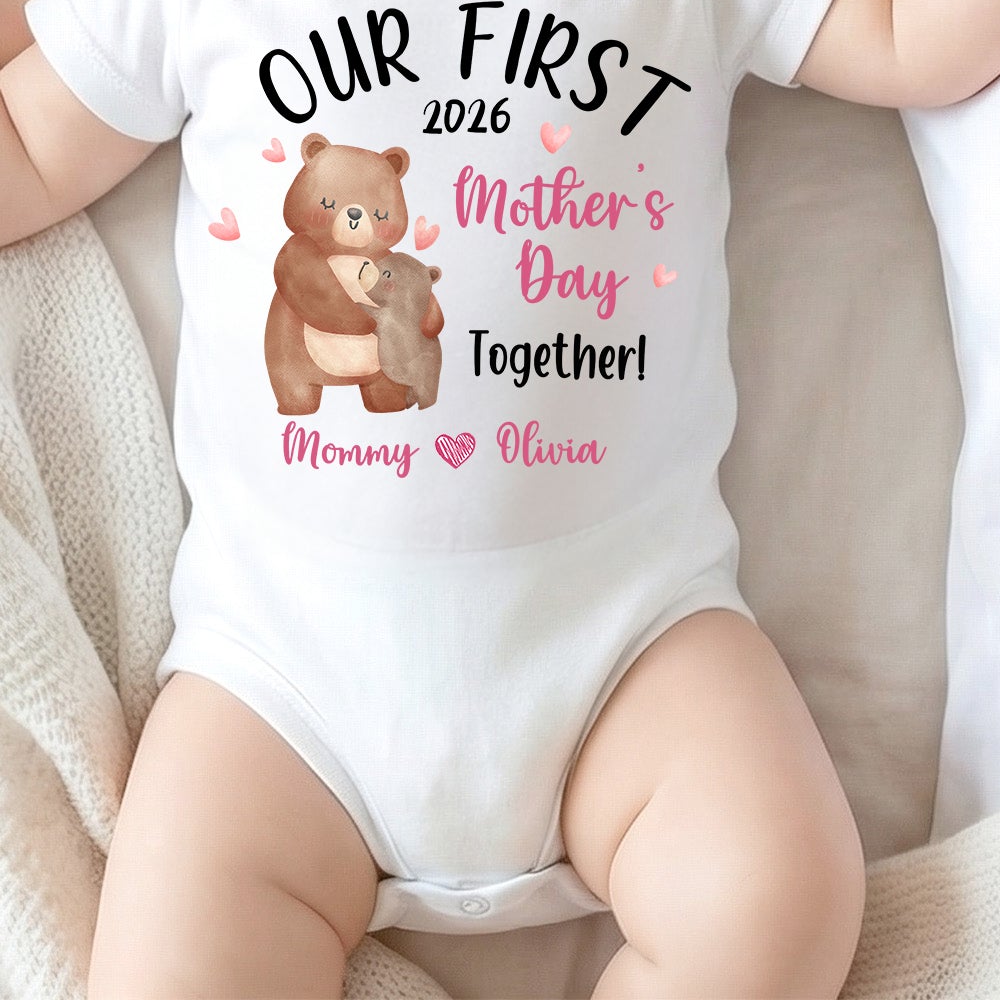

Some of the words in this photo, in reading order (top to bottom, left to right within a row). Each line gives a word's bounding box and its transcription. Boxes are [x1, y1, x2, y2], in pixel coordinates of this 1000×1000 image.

[259, 8, 419, 123] OUR
[459, 1, 691, 136] FIRST
[422, 97, 511, 135] 2026
[453, 164, 674, 235] Mother's
[515, 238, 630, 321] Day
[468, 329, 647, 389] Together!
[281, 420, 420, 479] Mommy
[496, 420, 608, 468] Olivia
